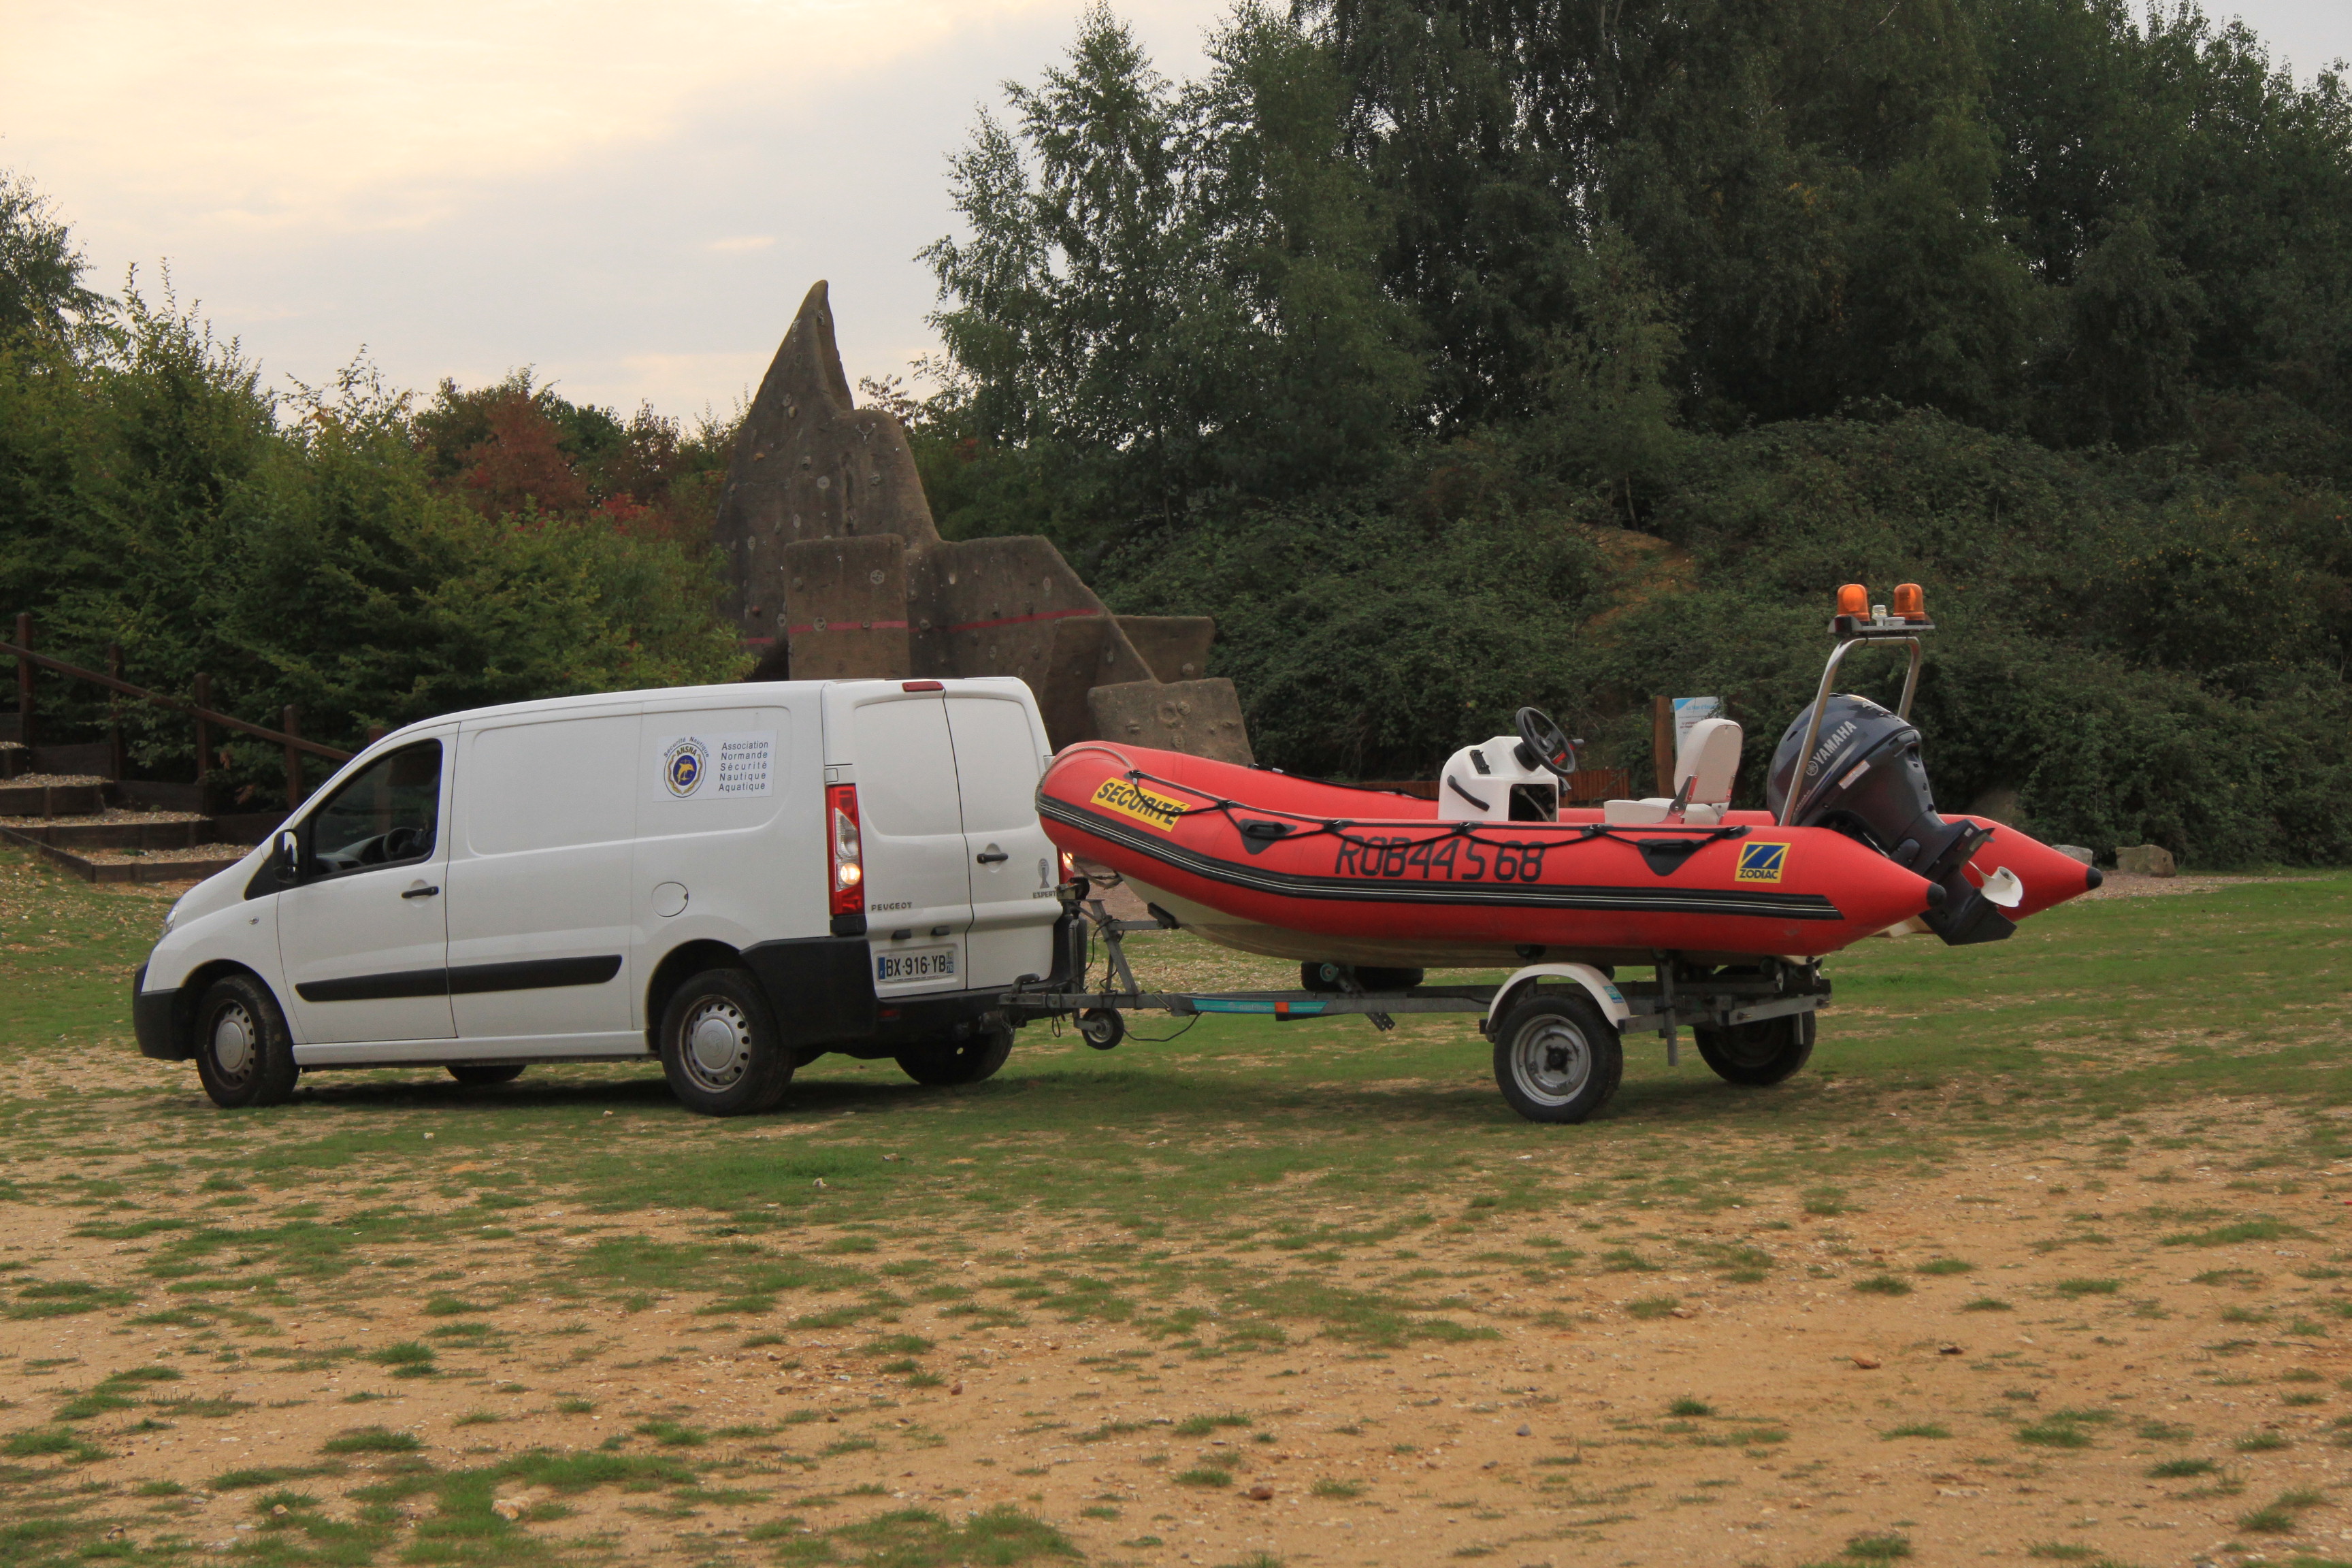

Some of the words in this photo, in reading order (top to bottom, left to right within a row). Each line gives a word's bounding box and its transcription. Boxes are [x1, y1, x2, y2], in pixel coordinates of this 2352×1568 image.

[664, 737, 687, 758] Sécurité
[689, 736, 709, 758] Nautique
[721, 741, 769, 751] Association
[1813, 720, 1857, 765] YAMAHA
[676, 745, 698, 757] ANSNA
[721, 751, 768, 761] Normande
[720, 762, 767, 771] Sécurité
[719, 772, 766, 782] Nautique
[718, 783, 766, 793] Aquatique
[1097, 782, 1186, 826] SÉCURITÉ
[1739, 869, 1778, 879] ZODIAC
[871, 902, 912, 911] PEUGEOT
